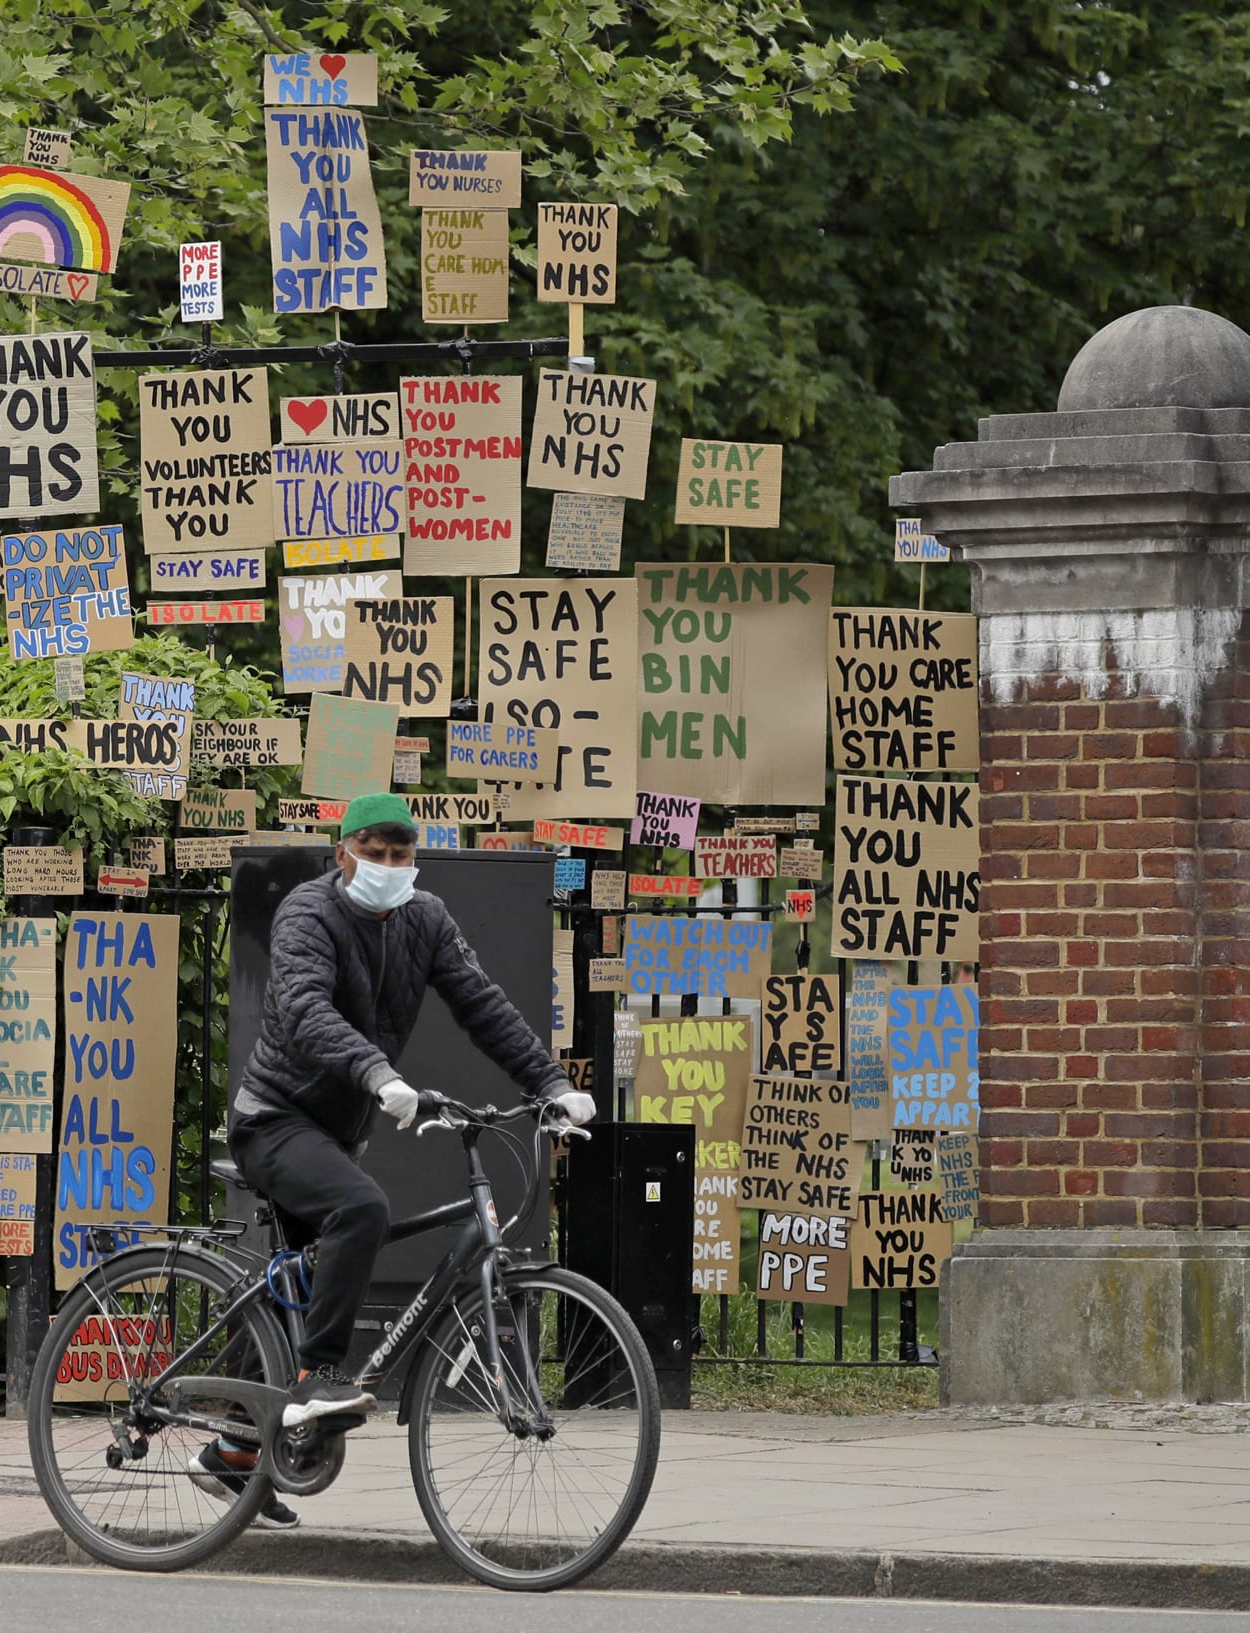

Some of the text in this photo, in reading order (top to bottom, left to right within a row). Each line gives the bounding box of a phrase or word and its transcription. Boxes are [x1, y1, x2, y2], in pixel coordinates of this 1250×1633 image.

[270, 55, 310, 76] WE
[279, 79, 348, 104] NHS
[29, 129, 69, 143] THANK
[270, 112, 365, 150] THANK
[29, 141, 51, 152] YOU
[28, 152, 59, 164] NHS
[415, 151, 486, 171] THANK
[416, 172, 502, 194] YOU NURSES
[426, 210, 483, 228] THANK
[280, 221, 368, 262] NHS
[426, 230, 462, 250] YOU
[181, 243, 218, 260] MORE
[424, 254, 465, 274] CARE
[181, 282, 217, 298] MORE
[544, 263, 609, 296] NHS
[181, 300, 214, 315] TESTS
[427, 292, 477, 314] STAFF
[145, 450, 271, 482] VOLUNTEERS
[272, 449, 400, 475] THANK YOU
[691, 443, 764, 472] STAY
[407, 464, 460, 484] AND
[408, 487, 486, 509] POST-
[410, 518, 512, 541] WOMEN
[156, 558, 260, 579] STAY SAFE
[151, 601, 262, 623] ISOLATE
[375, 623, 428, 656] YOU
[122, 675, 195, 710] THANK
[344, 661, 442, 706] NHS
[220, 722, 257, 736] YOUR
[451, 724, 536, 747] MORE PPE
[641, 711, 746, 760] MEN
[266, 738, 278, 750] IF
[223, 752, 278, 764] ARE OK
[451, 746, 538, 770] FOR CARERS
[453, 796, 489, 820] YOU
[636, 792, 695, 818] THANK
[641, 815, 670, 830] YOU
[7, 858, 23, 866] WHO
[34, 848, 48, 856] YOU
[6, 866, 24, 874] LONG
[69, 1033, 135, 1083] YOU
[60, 1146, 155, 1212] NHS
[20, 1204, 35, 1218] PPE
[370, 1291, 430, 1370] Belmont
[57, 1350, 102, 1384] BUS
